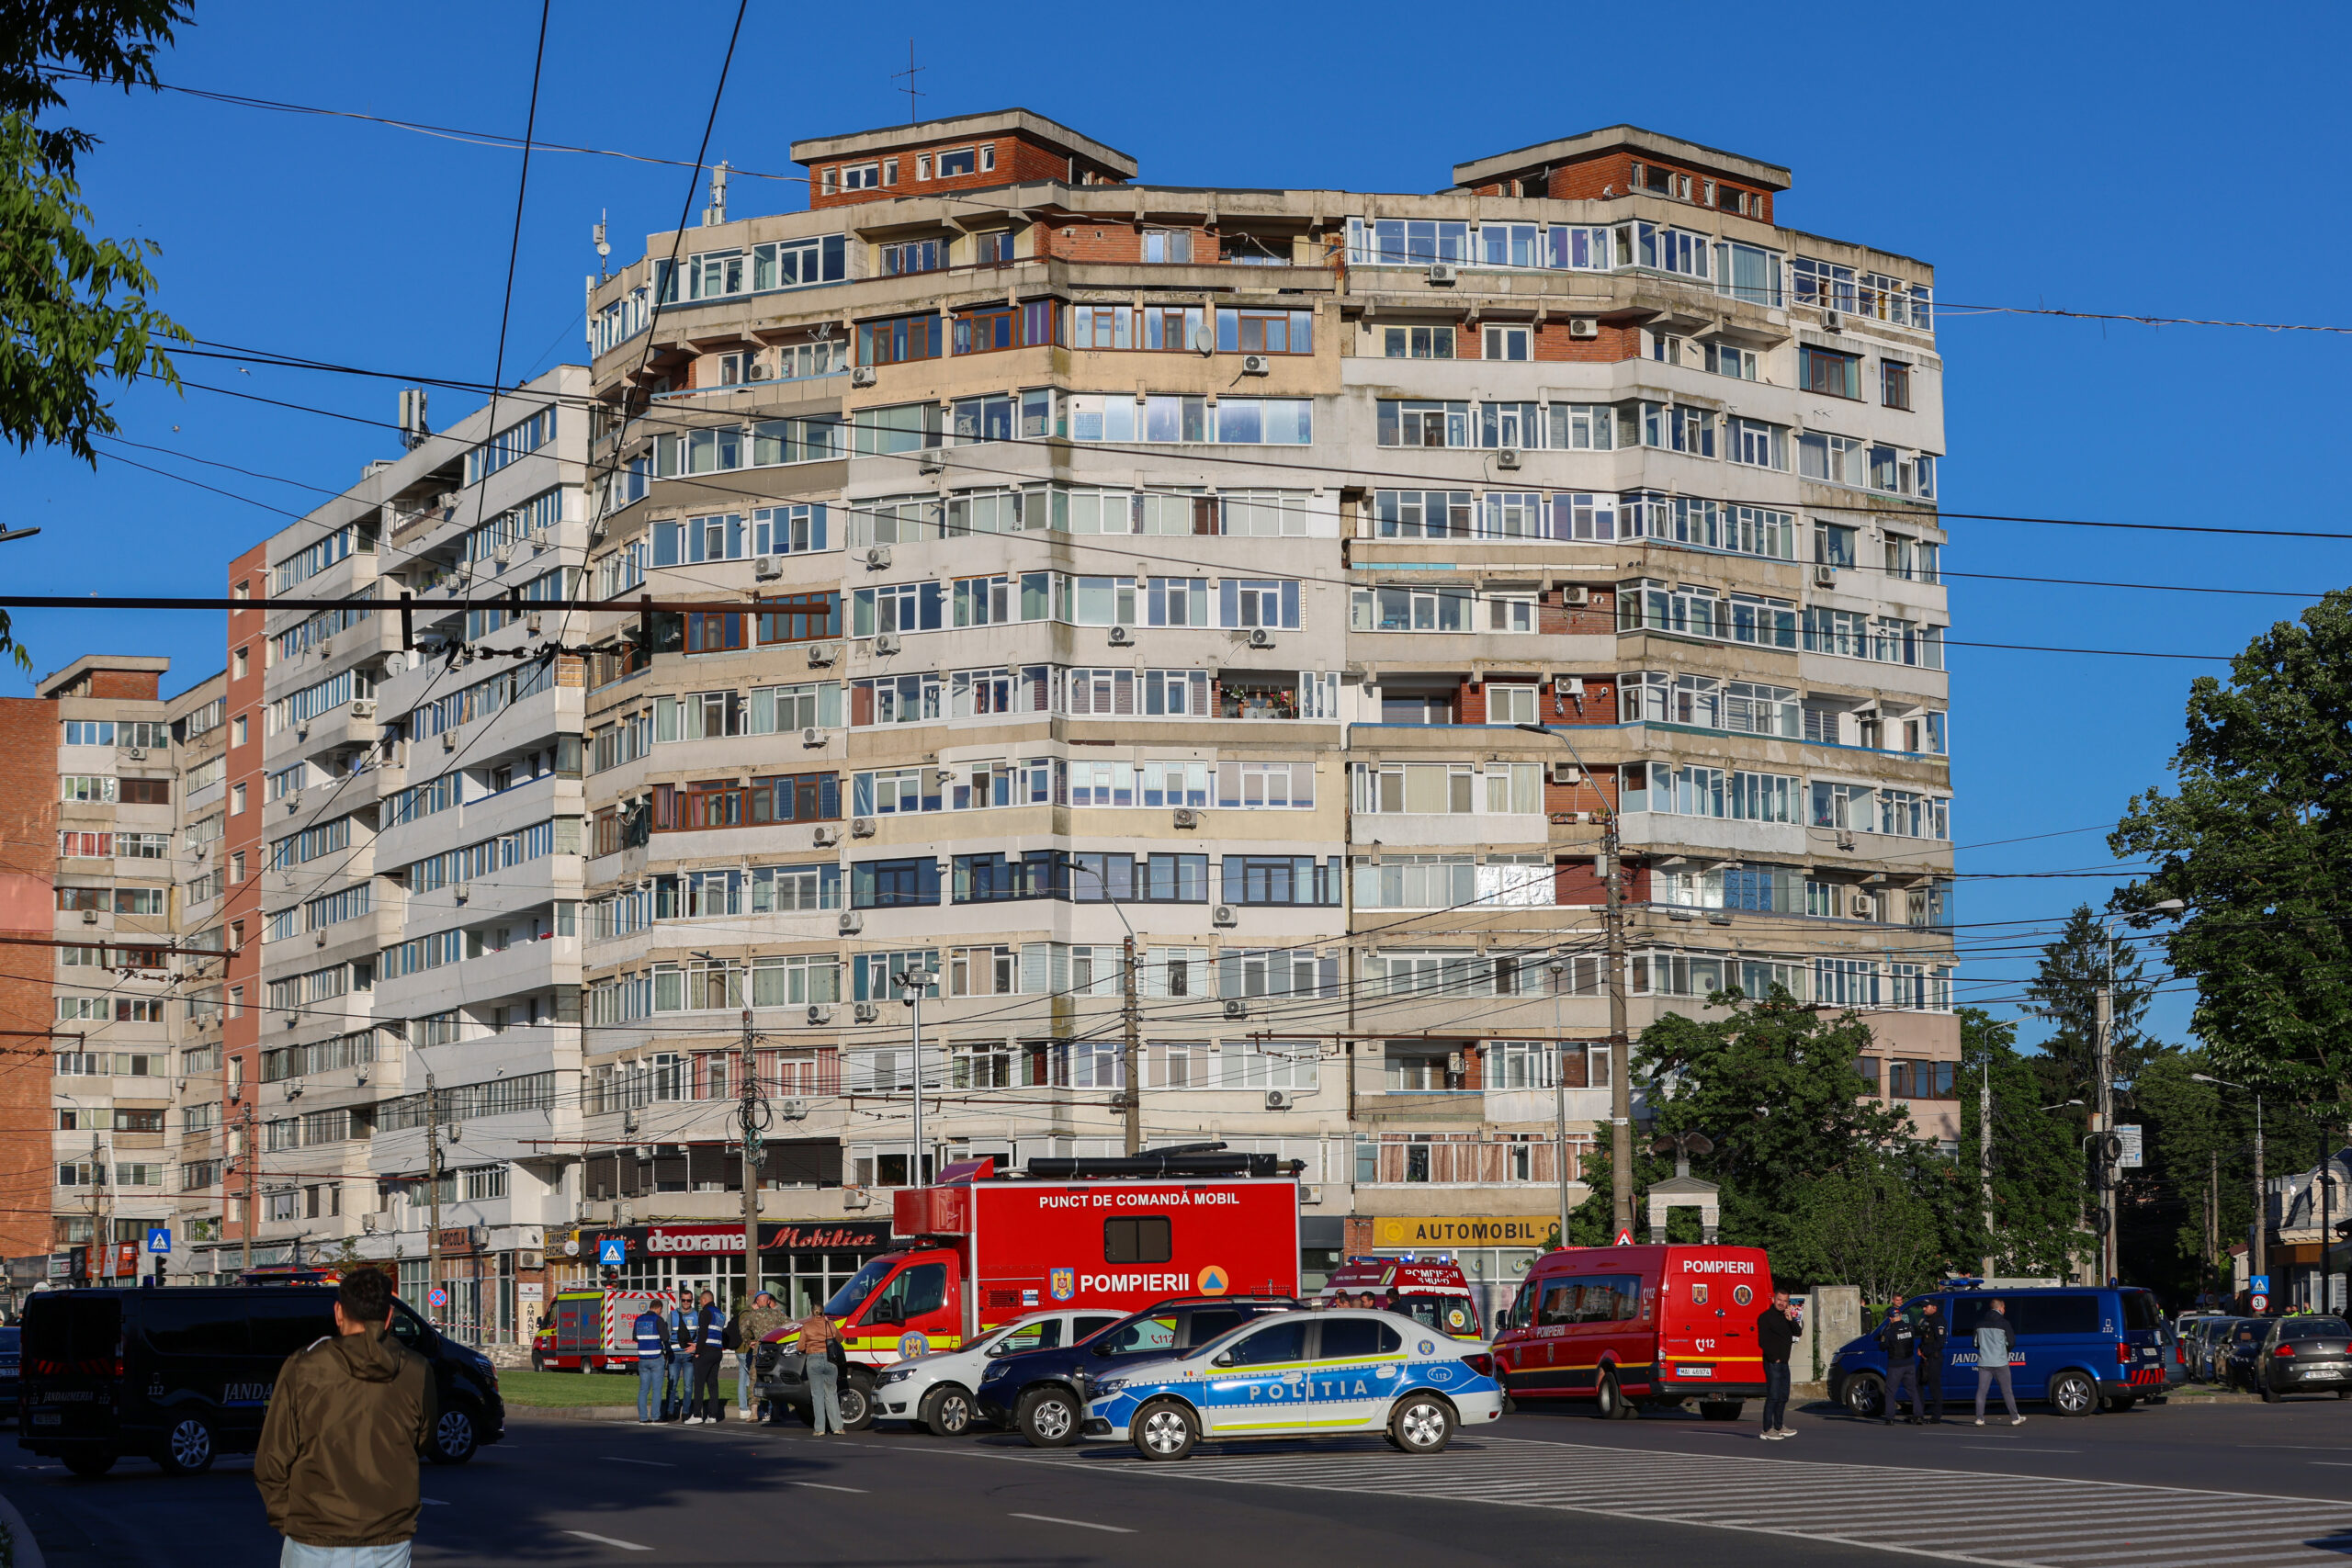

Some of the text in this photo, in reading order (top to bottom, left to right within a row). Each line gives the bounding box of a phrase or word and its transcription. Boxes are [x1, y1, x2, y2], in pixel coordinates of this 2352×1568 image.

[1039, 1190, 1239, 1209] PUNCT DE COMANDĂ MOBIL
[1416, 1223, 1535, 1240] AUTOMOBIL
[647, 1229, 747, 1252] decorama
[1683, 1260, 1755, 1274] POMPIERII
[1080, 1273, 1190, 1292] POMPIERII
[526, 1303, 535, 1345] AMANET
[1536, 1325, 1566, 1338] POMPIERII
[1159, 1334, 1176, 1344] 112
[1700, 1338, 1715, 1348] 112
[1951, 1351, 2026, 1366] JANDRIA
[1434, 1372, 1447, 1381] 112
[147, 1385, 164, 1395] 112
[1249, 1380, 1368, 1401] POLITIA
